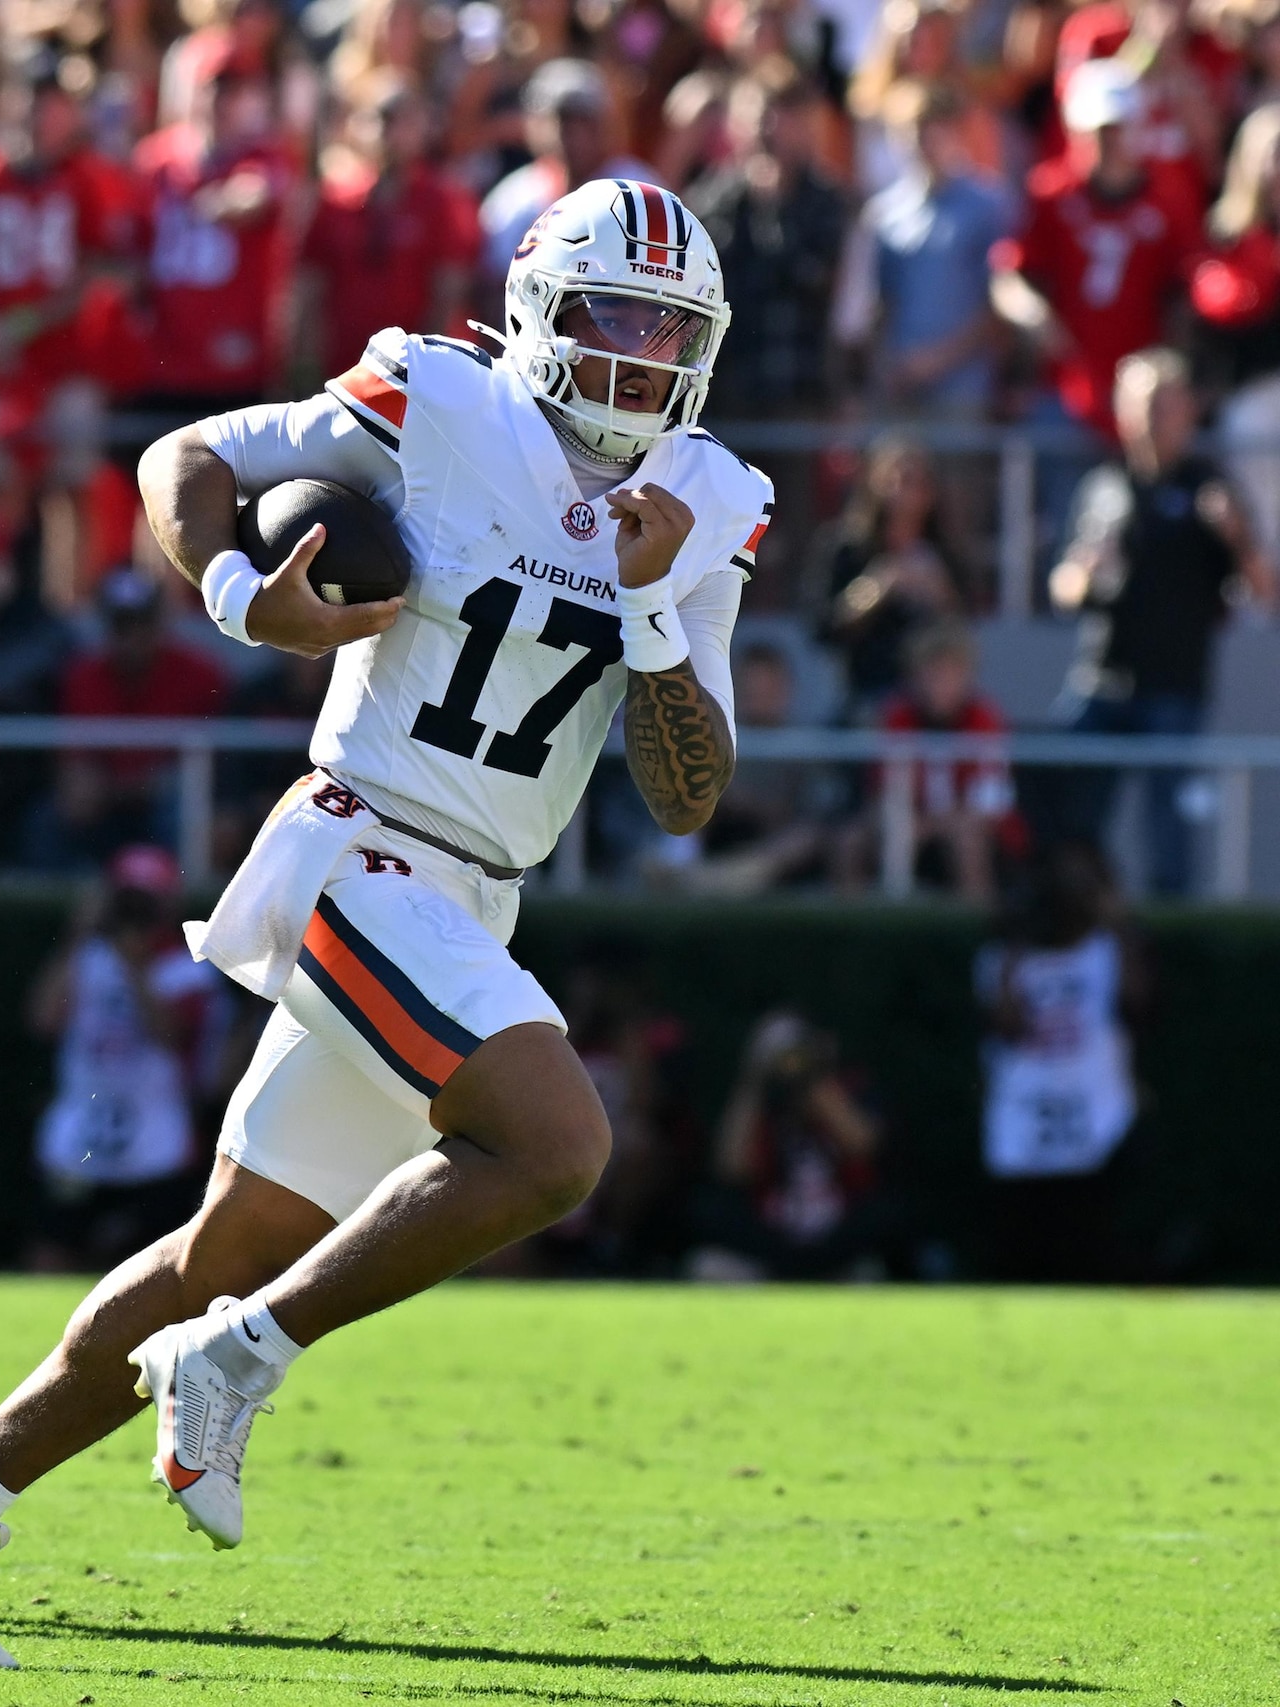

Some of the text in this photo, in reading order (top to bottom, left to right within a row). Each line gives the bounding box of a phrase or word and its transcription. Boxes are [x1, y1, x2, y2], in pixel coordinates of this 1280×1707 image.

[576, 261, 589, 273] 17
[629, 262, 684, 282] TIGERS
[707, 288, 716, 300] 17
[570, 503, 593, 531] SEC
[508, 554, 617, 602] AUBURN
[409, 576, 626, 779] 17
